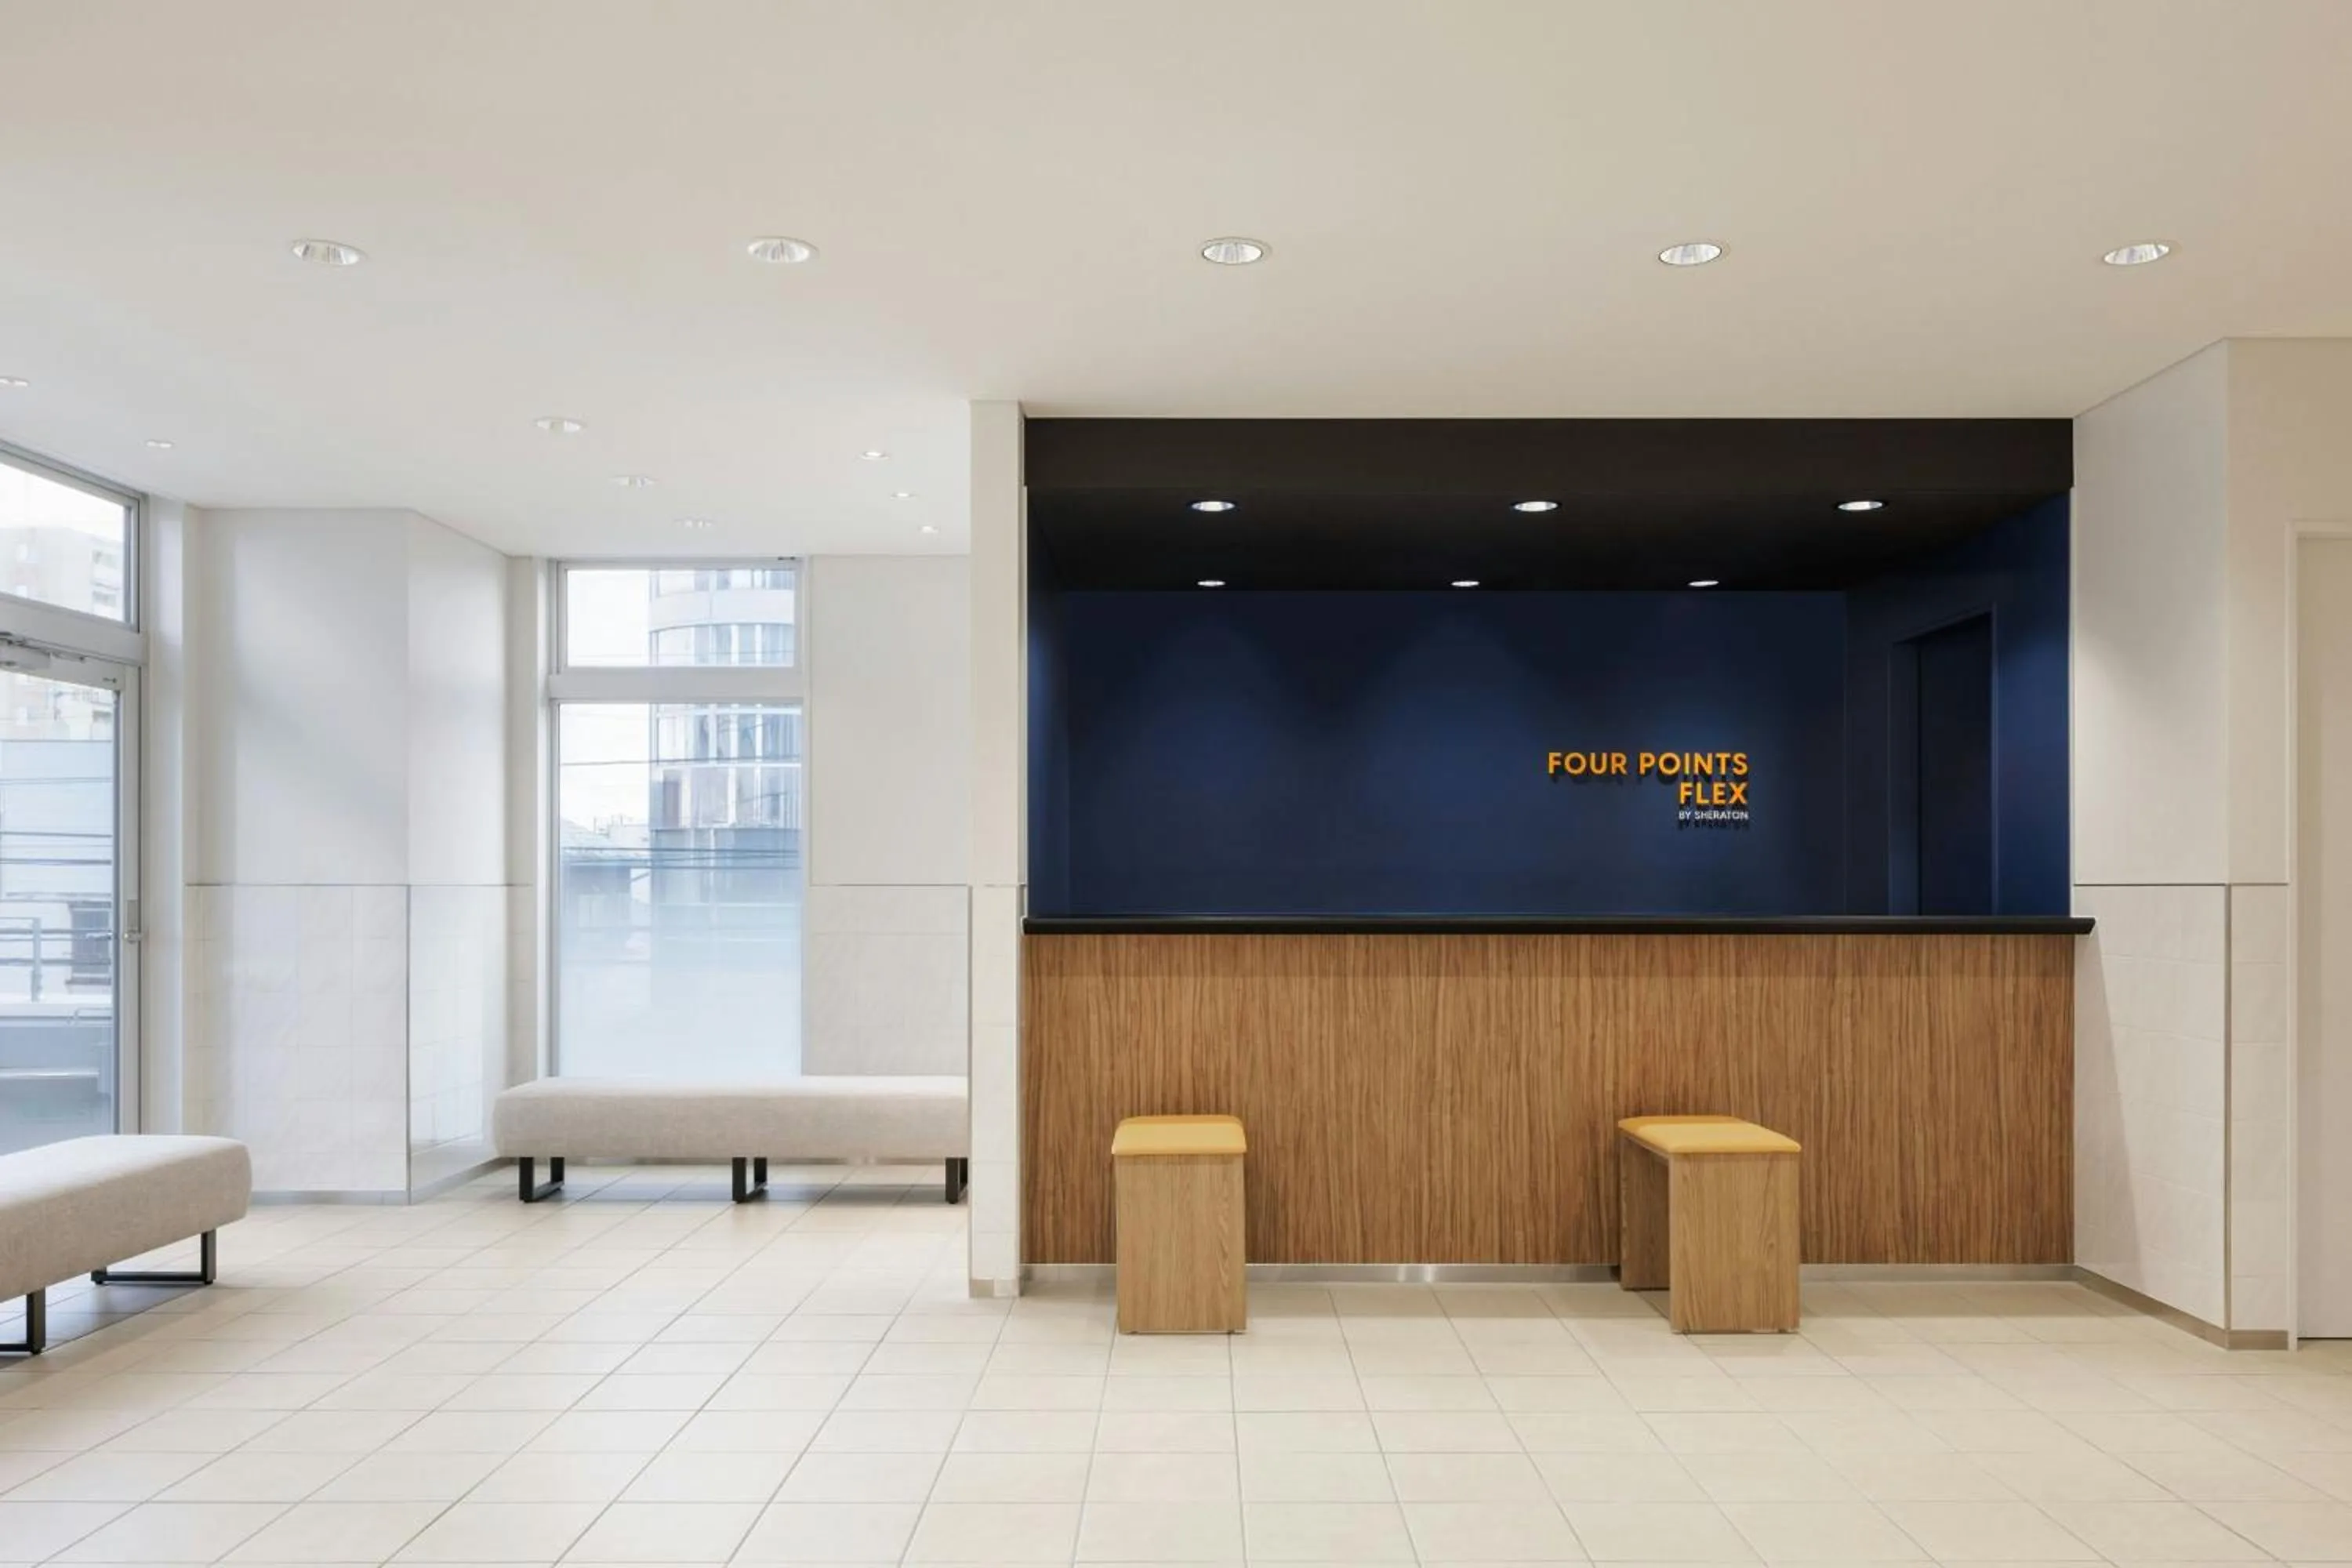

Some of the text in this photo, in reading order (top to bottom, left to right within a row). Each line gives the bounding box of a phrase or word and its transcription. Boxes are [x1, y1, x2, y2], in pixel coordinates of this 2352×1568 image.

[1548, 752, 1748, 775] FOUR POINTS
[1679, 782, 1748, 804] FLEX
[1679, 811, 1749, 820] BY SHERATON
